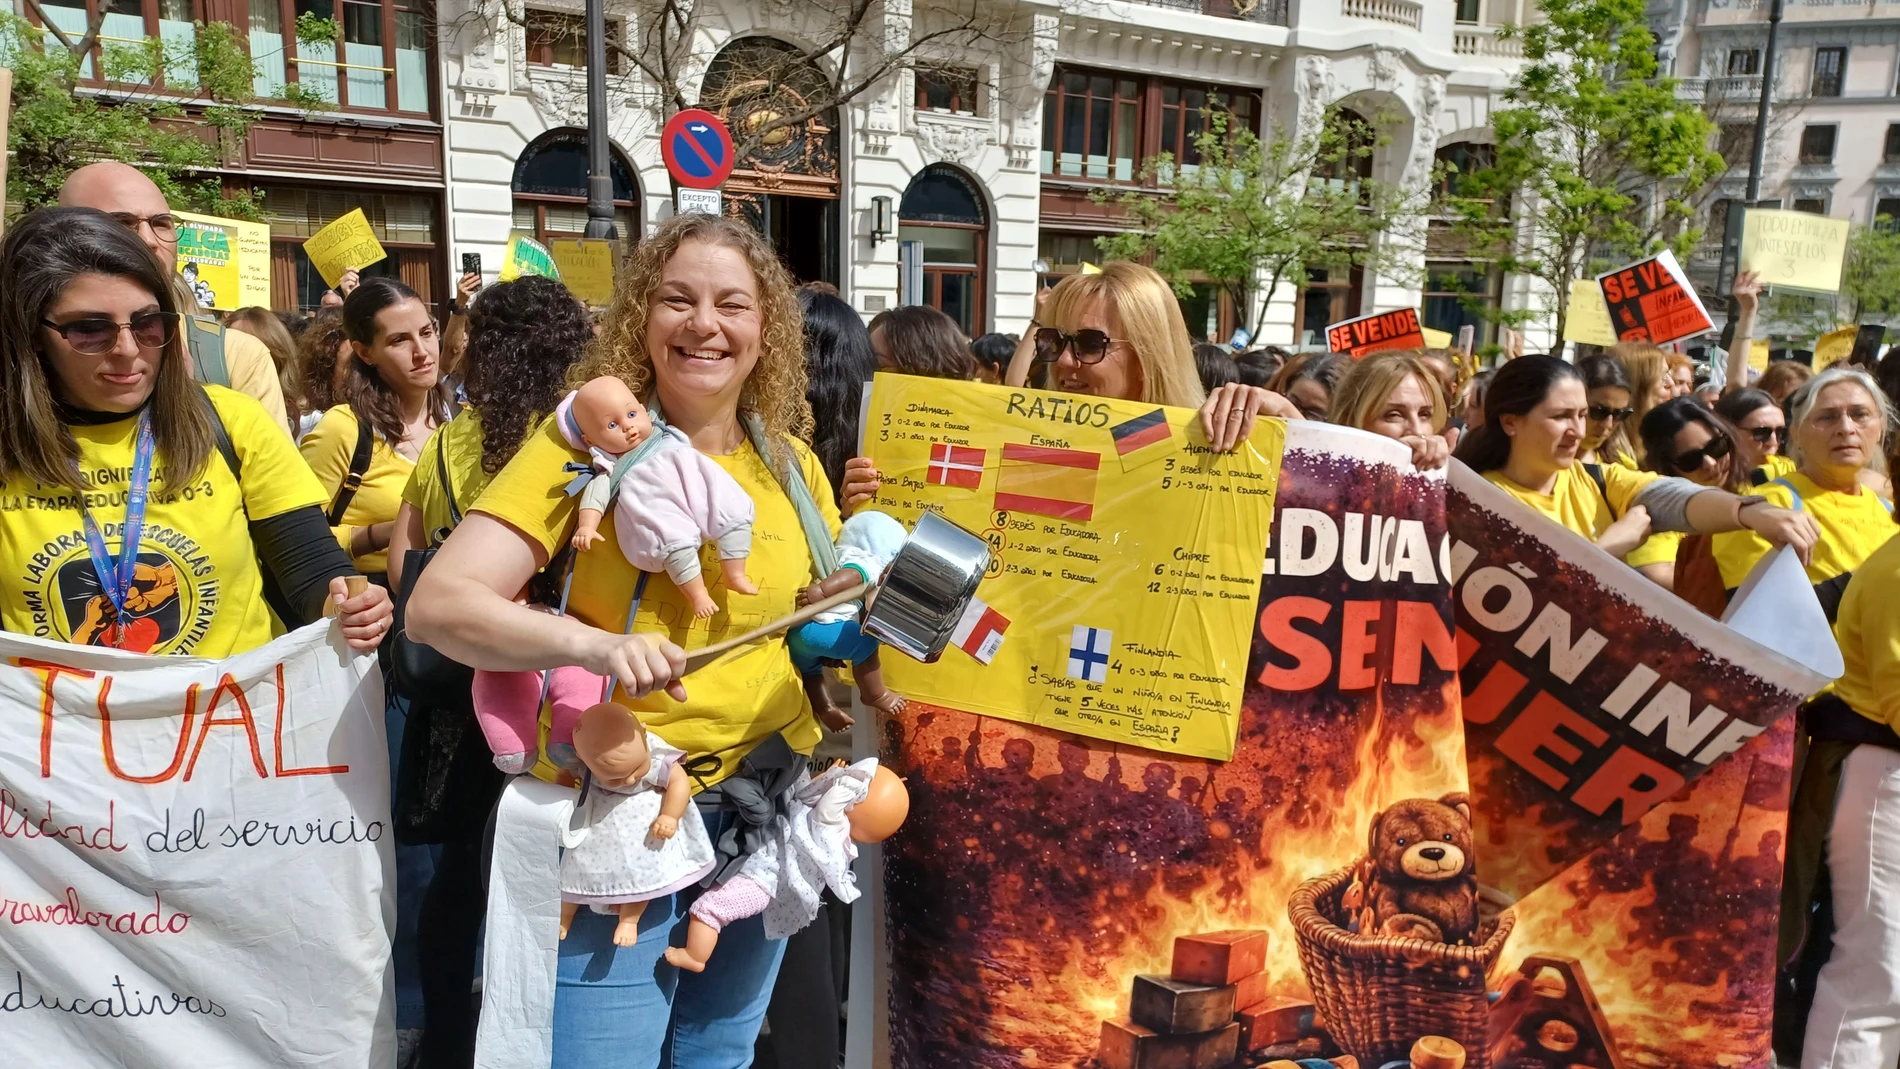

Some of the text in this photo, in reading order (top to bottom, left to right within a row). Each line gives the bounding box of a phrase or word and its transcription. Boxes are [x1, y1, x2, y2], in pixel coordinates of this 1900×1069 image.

[682, 193, 717, 203] EXCEPTO
[176, 227, 231, 252] ELGA
[1781, 259, 1796, 279] 3
[1603, 268, 1640, 304] SE
[1330, 325, 1353, 353] SE
[1352, 309, 1420, 345] VENDE
[882, 413, 892, 426] 3
[879, 429, 889, 442] 3
[1030, 434, 1070, 449] ESPAÑA
[1164, 458, 1176, 471] 3
[1162, 476, 1172, 489] 5
[2, 495, 22, 512] LA
[26, 494, 80, 512] ETAPA
[996, 511, 1007, 526] 8
[1043, 525, 1056, 534] POR
[23, 530, 87, 584] LABORA
[987, 559, 999, 573] 0
[1005, 564, 1019, 574] 2-3
[1154, 563, 1165, 576] 6
[1146, 581, 1161, 593] 12
[1166, 586, 1179, 595] 2-3
[23, 590, 55, 641] ORMA
[168, 578, 219, 656] INFANTILE
[1111, 659, 1123, 674] 4
[1129, 668, 1146, 677] 0-3
[1081, 696, 1094, 707] 5
[1096, 699, 1120, 711] VECES
[1127, 704, 1143, 716] MÁS
[1169, 694, 1182, 703] EN
[1078, 712, 1104, 725] OTRO/A
[0, 788, 386, 853] lidad del servicio
[0, 886, 192, 936] ravalorado
[0, 970, 227, 1018] ducativas
